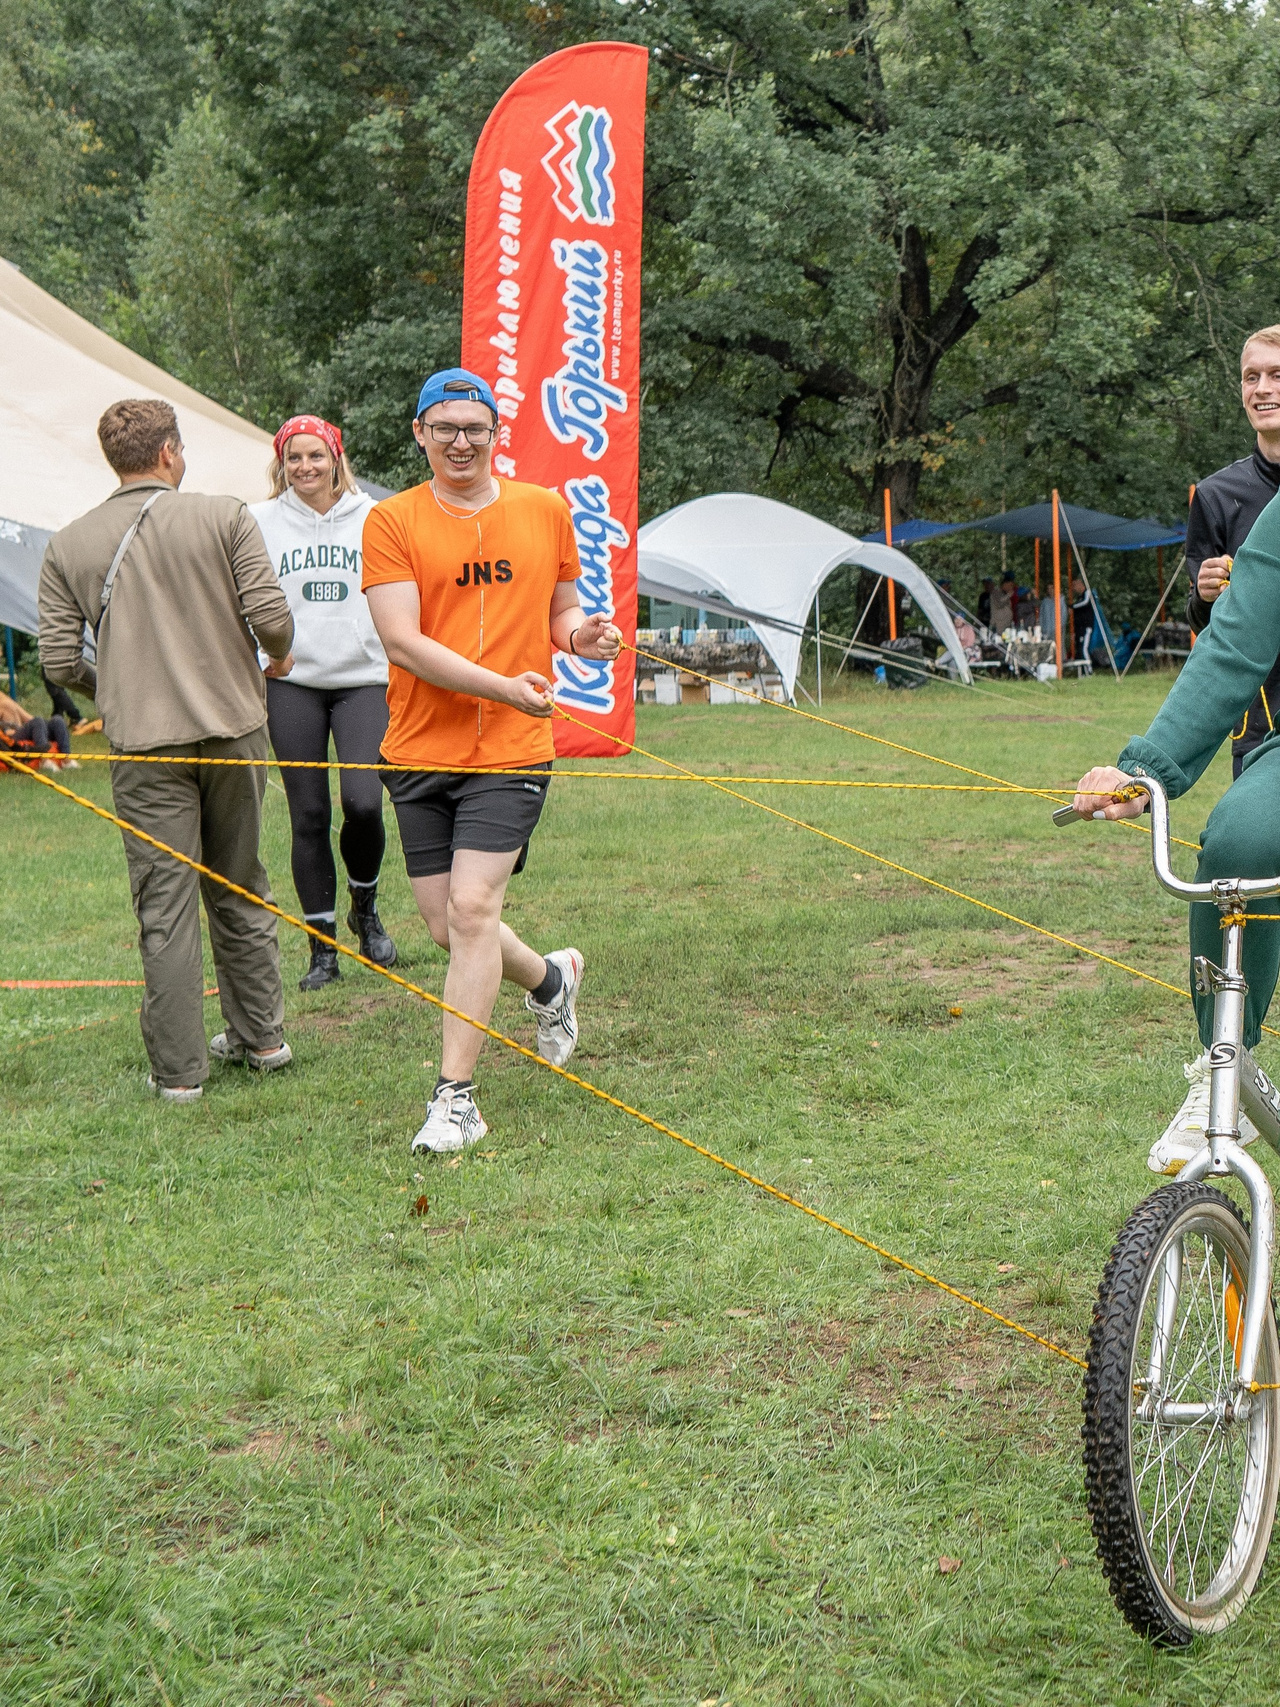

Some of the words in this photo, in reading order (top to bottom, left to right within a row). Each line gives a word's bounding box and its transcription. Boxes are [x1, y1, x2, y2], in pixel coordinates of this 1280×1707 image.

[610, 249, 625, 380] www.teamgorky.ru
[542, 238, 627, 461] Горький
[279, 545, 363, 578] ACADEM
[456, 559, 513, 587] JNS
[310, 583, 340, 600] 1988
